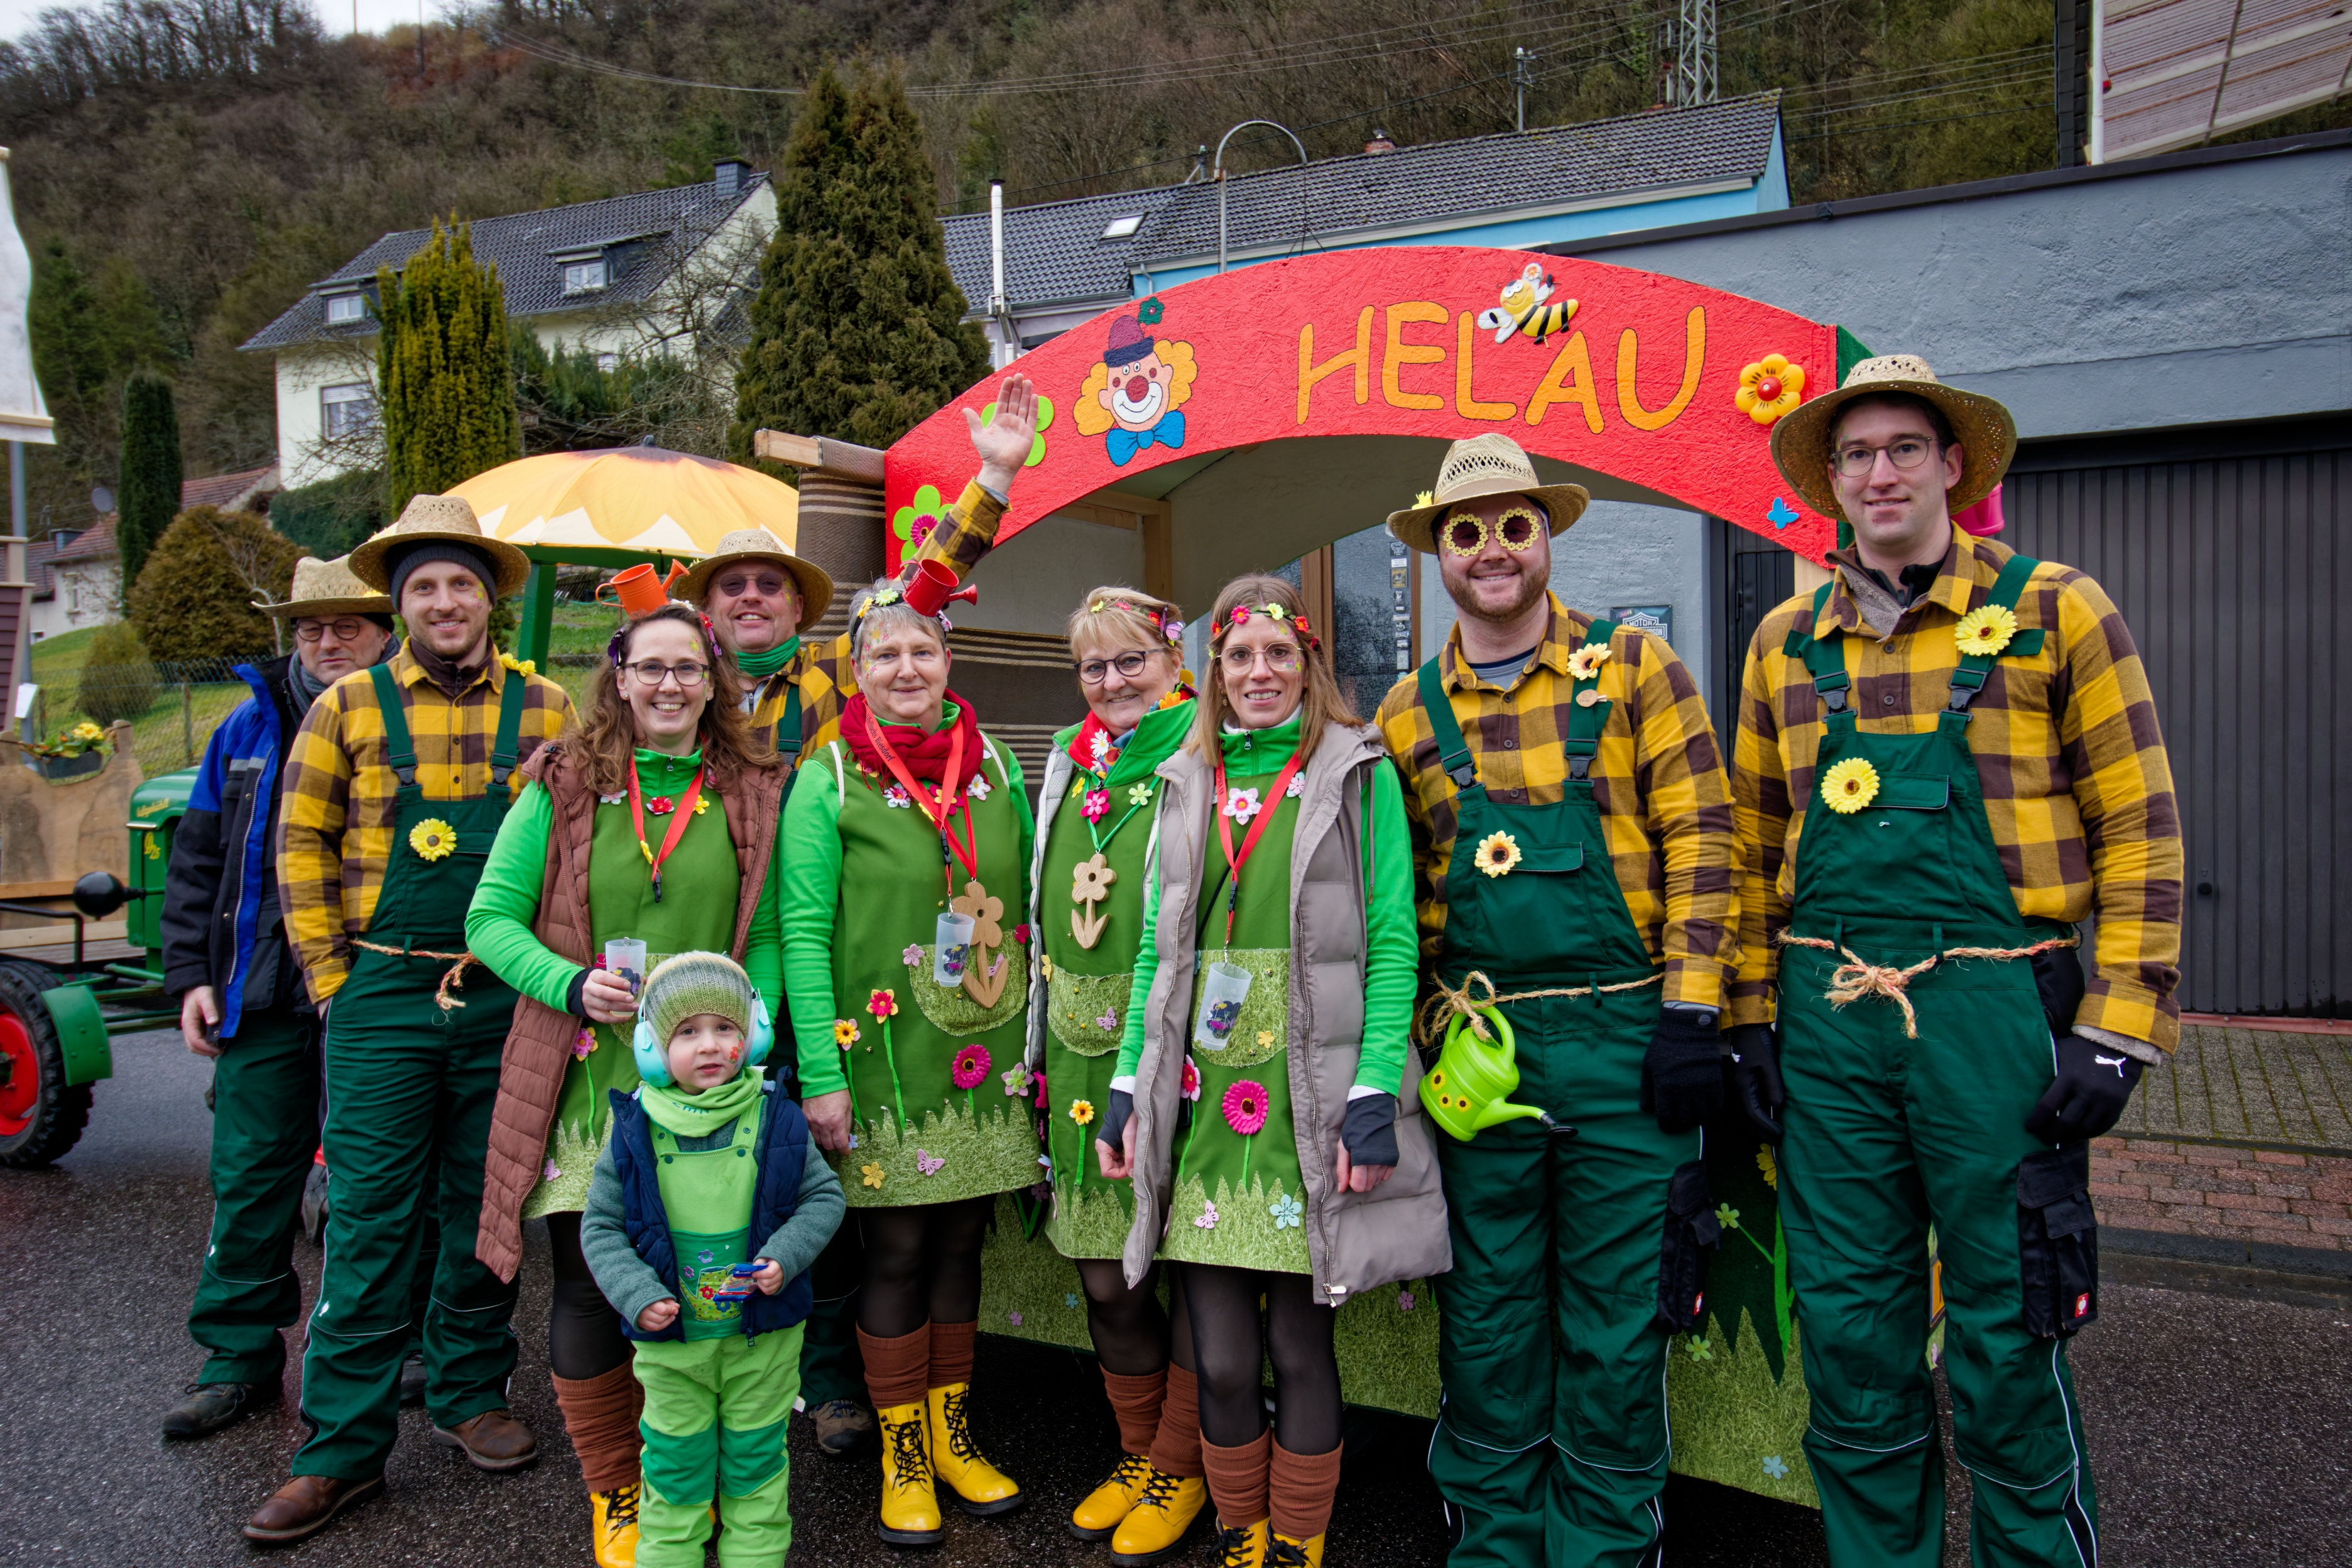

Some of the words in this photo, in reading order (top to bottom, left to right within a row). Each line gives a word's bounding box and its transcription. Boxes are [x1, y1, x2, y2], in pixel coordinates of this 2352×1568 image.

[1296, 300, 1707, 435] HELAU
[1629, 618, 1653, 626] MOTOR
[874, 736, 896, 761] Biesdorf
